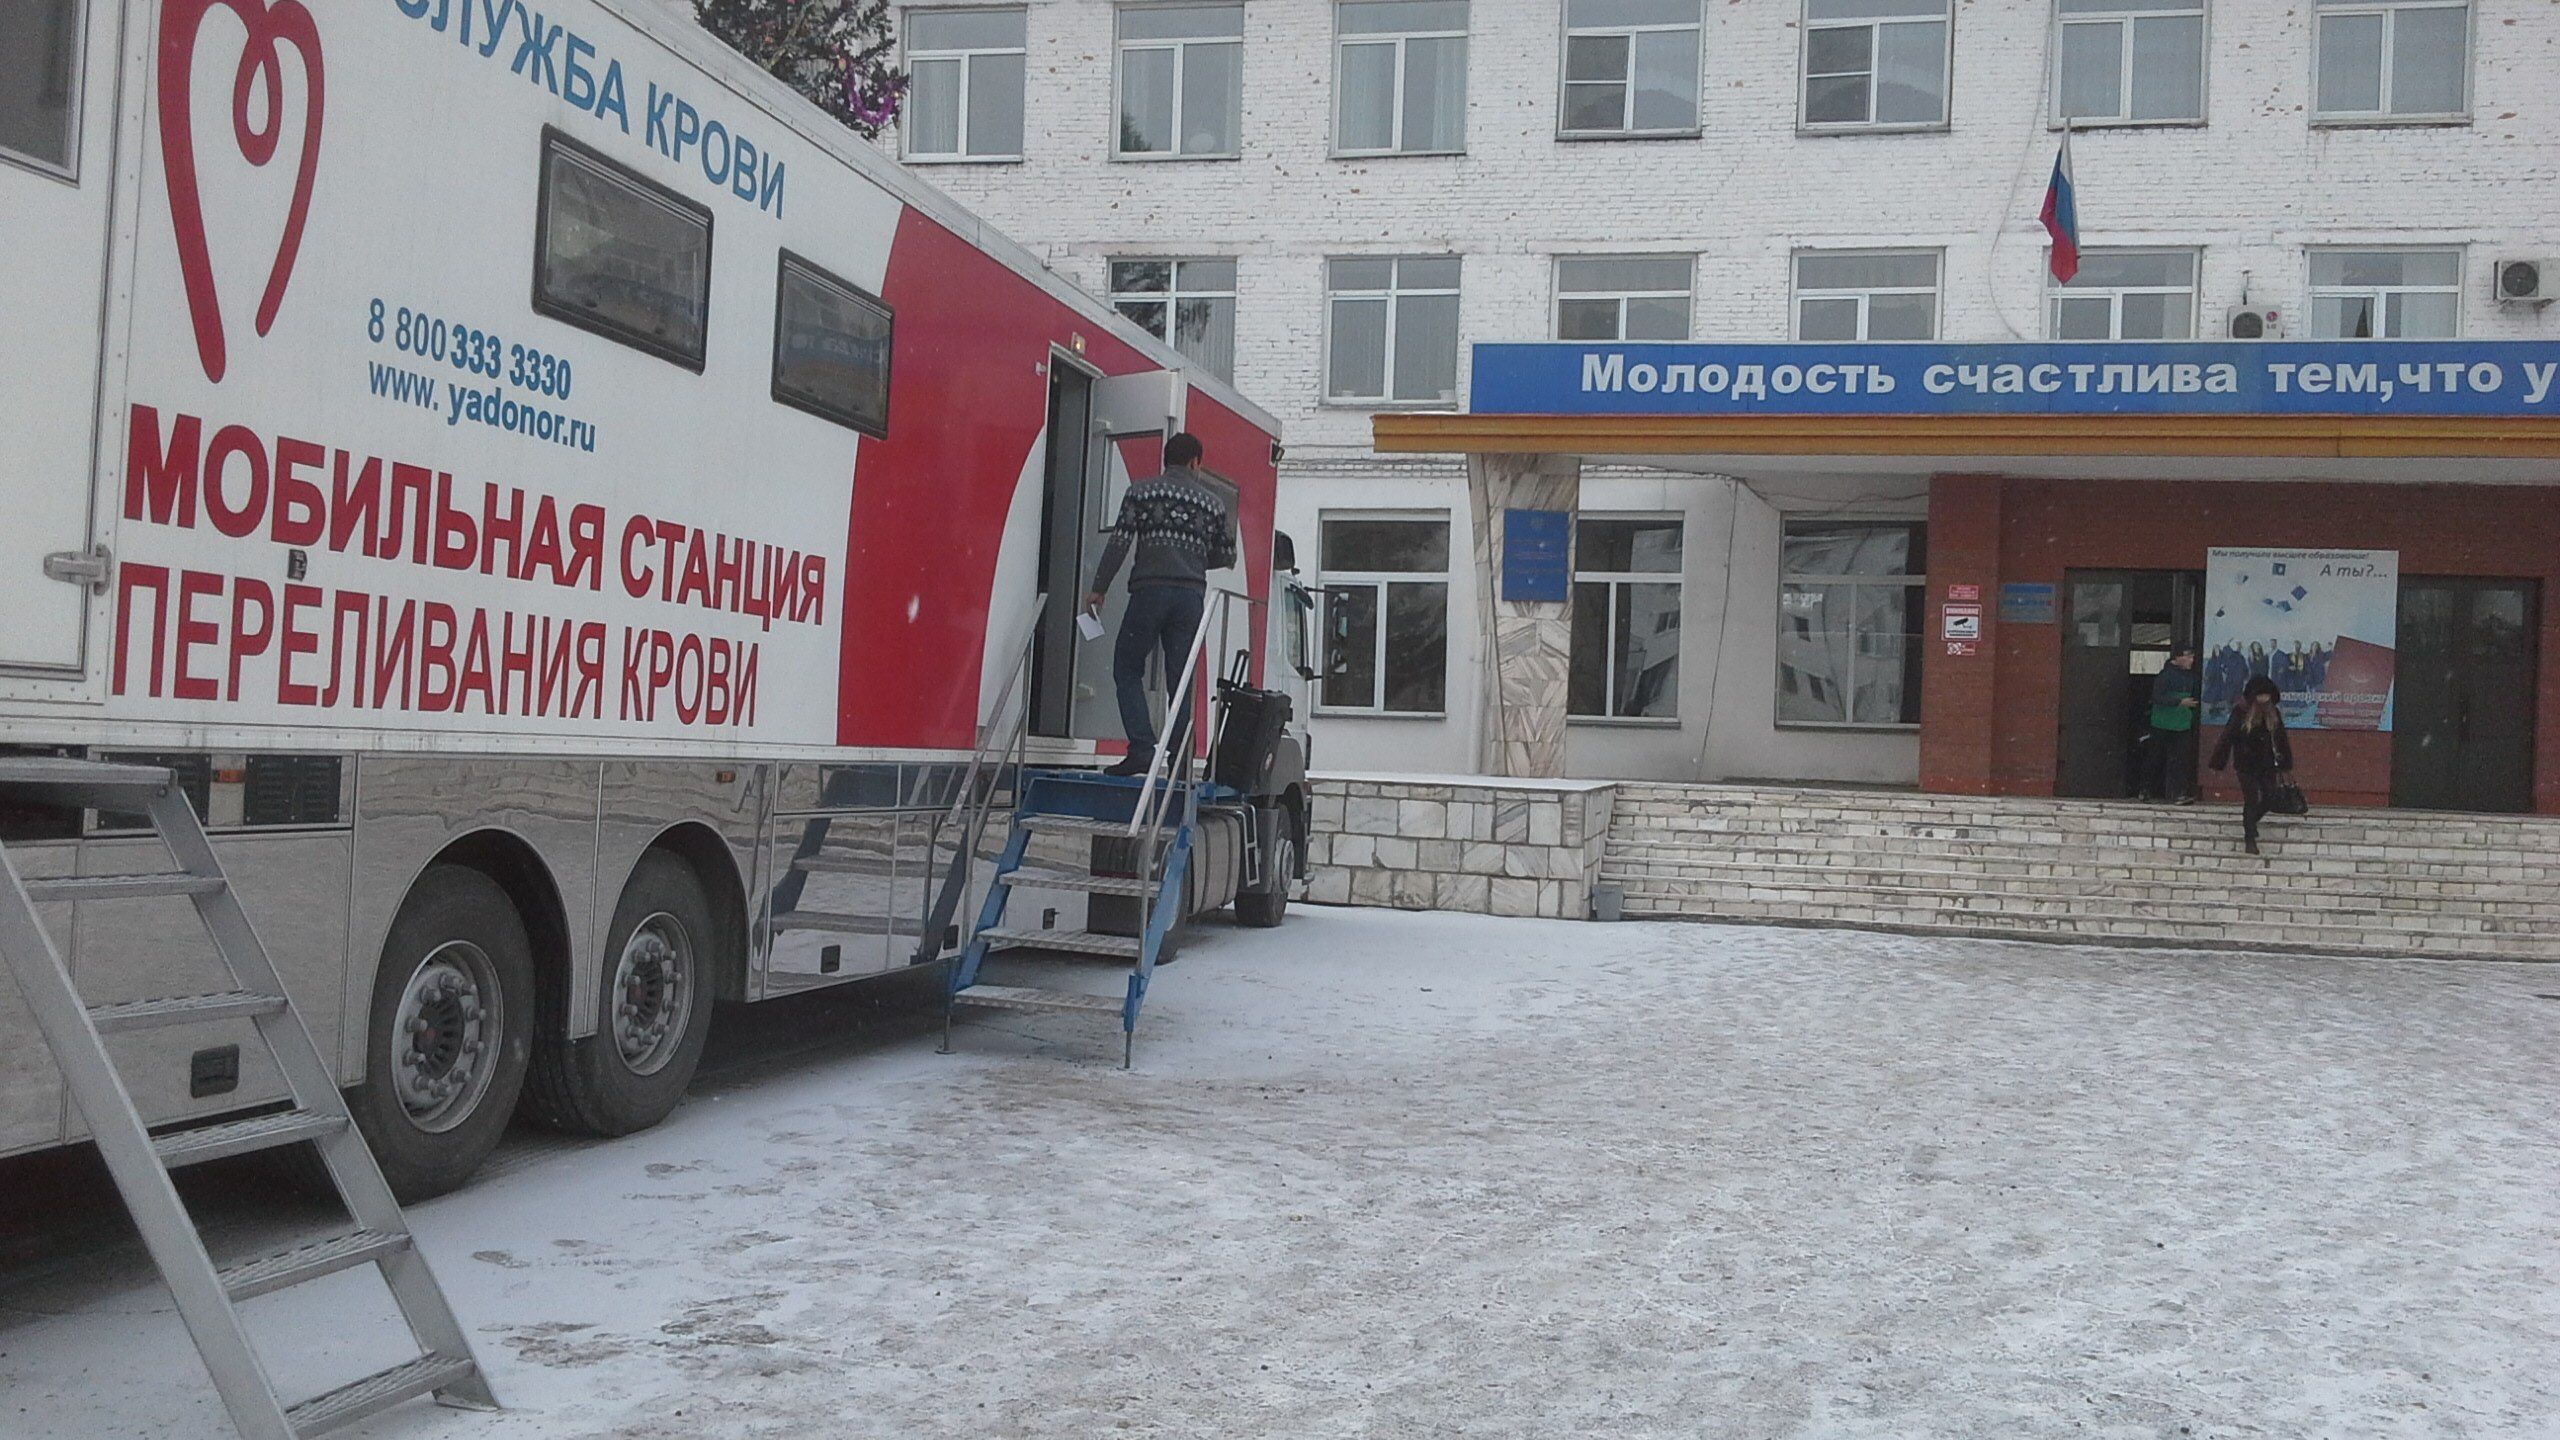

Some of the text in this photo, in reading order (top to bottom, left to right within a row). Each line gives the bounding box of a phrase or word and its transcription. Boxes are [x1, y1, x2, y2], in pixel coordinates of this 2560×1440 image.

[395, 0, 785, 220] ЛУЖБА КРОВИ
[367, 297, 572, 400] 8 800 333 3330
[1581, 353, 1896, 401] Молодость
[1922, 363, 2239, 394] счастлива
[2522, 362, 2558, 404] у
[124, 404, 827, 631] МОБИЛЬНАЯ СТАНЦИЯ
[2319, 563, 2332, 577] А
[111, 561, 761, 728] ПЕРЕЛИВАНИЯ КРОВИ
